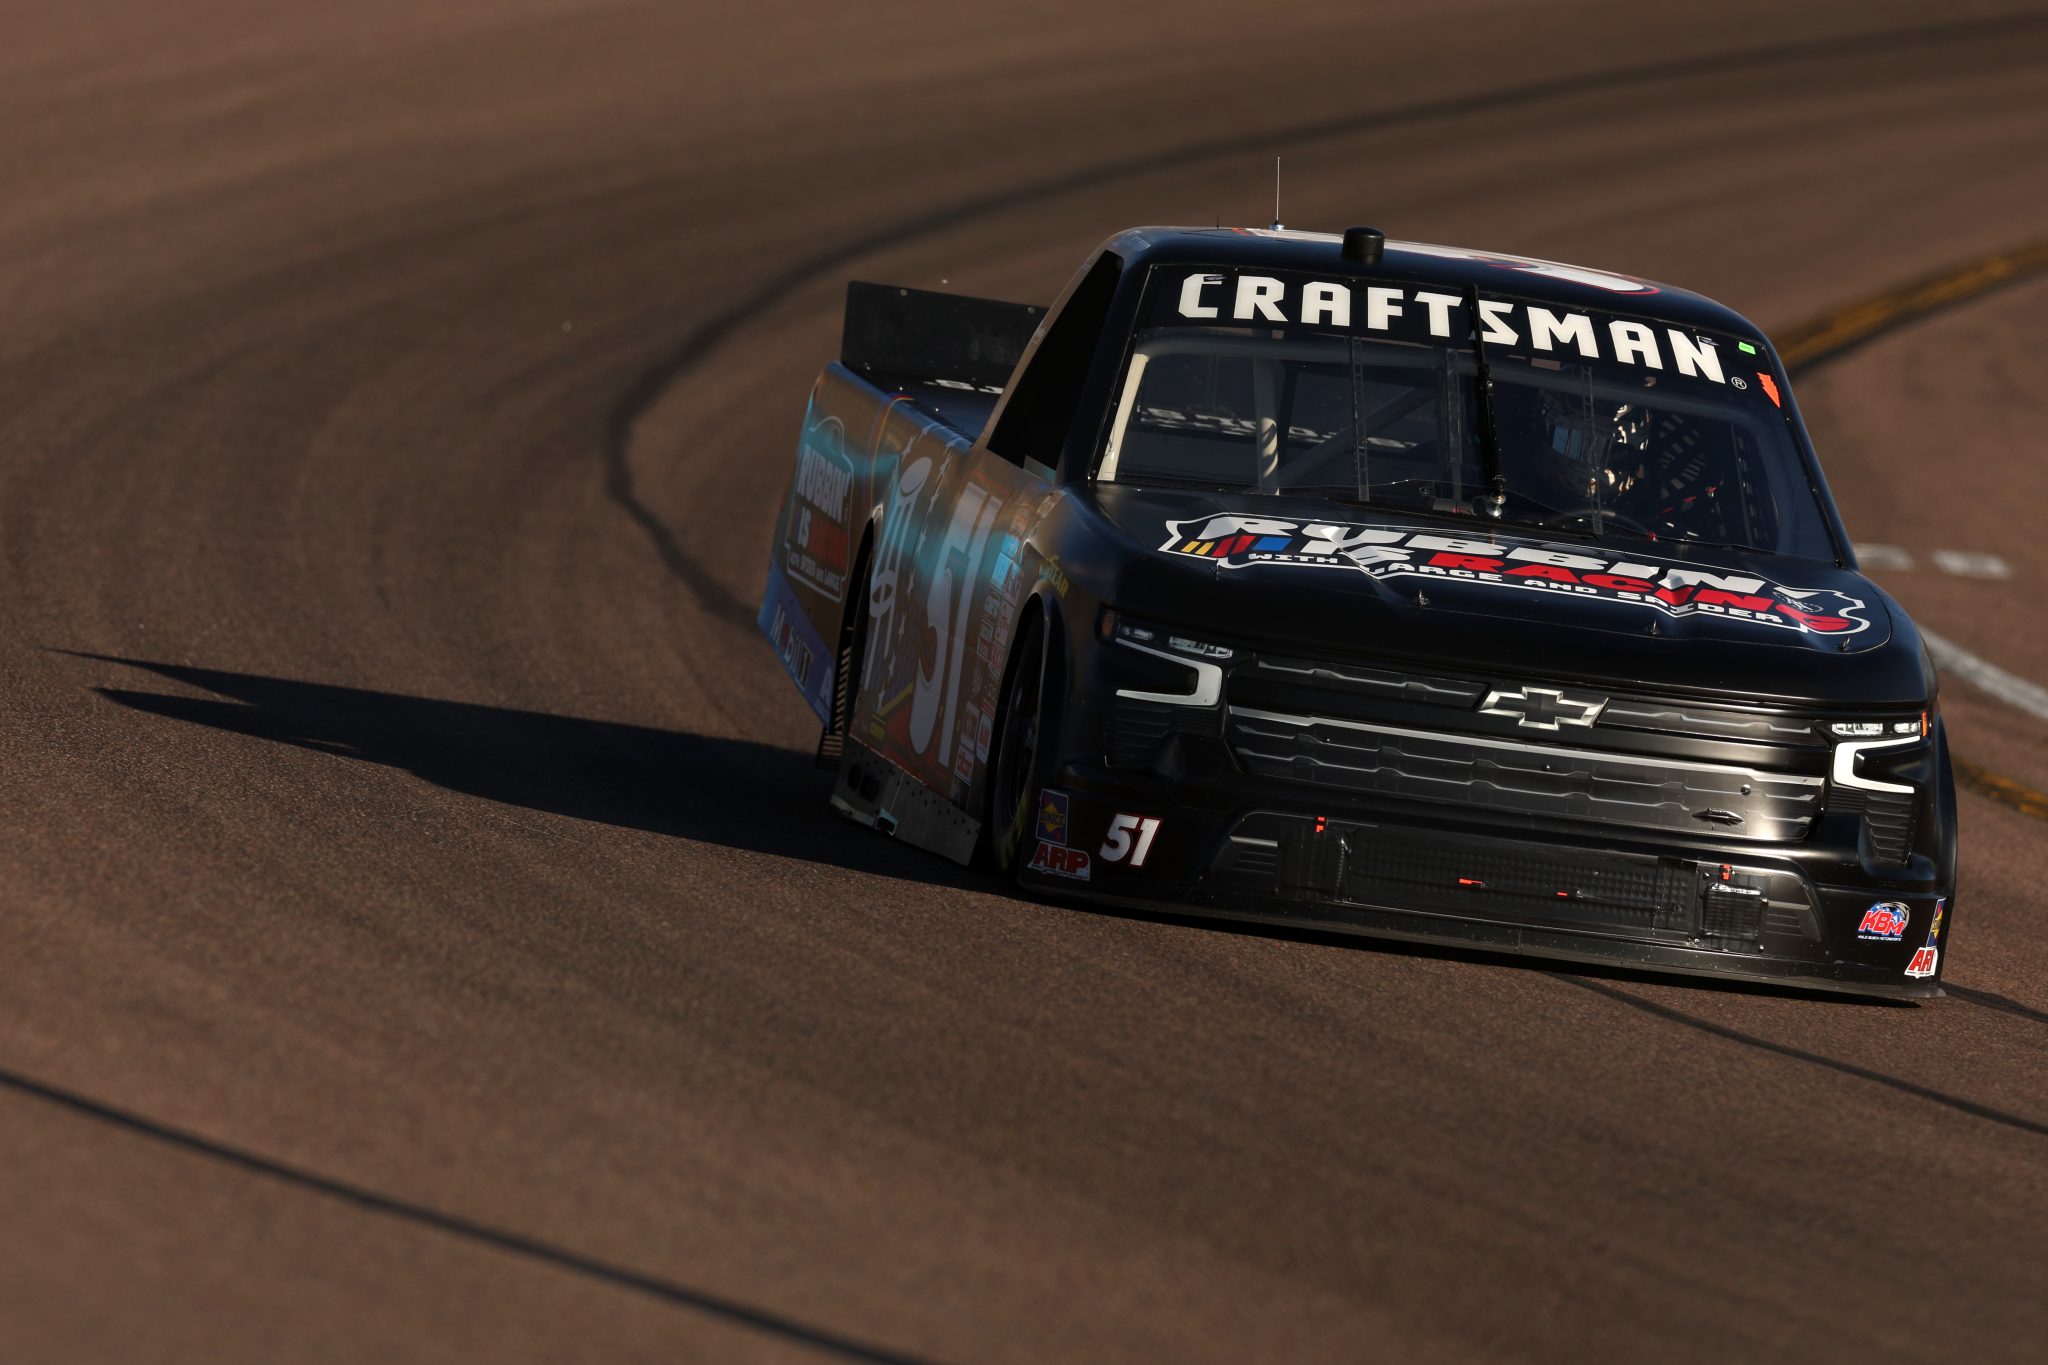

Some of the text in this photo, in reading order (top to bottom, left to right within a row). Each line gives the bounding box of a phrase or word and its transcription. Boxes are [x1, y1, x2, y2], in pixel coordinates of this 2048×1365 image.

[1178, 274, 1726, 384] CRAFTSMAN
[797, 444, 851, 523] RUBBIN'
[798, 507, 812, 548] IS
[1248, 553, 1338, 565] WITH
[1360, 564, 1502, 582] LARGE
[1524, 579, 1598, 594] AND
[1617, 591, 1783, 624] SPIDER
[1427, 552, 1850, 631] RACING
[770, 603, 802, 673] Mobil
[908, 481, 1003, 769] 51
[1032, 842, 1089, 875] ARP
[1100, 813, 1161, 866] 51
[1858, 909, 1906, 936] KBM
